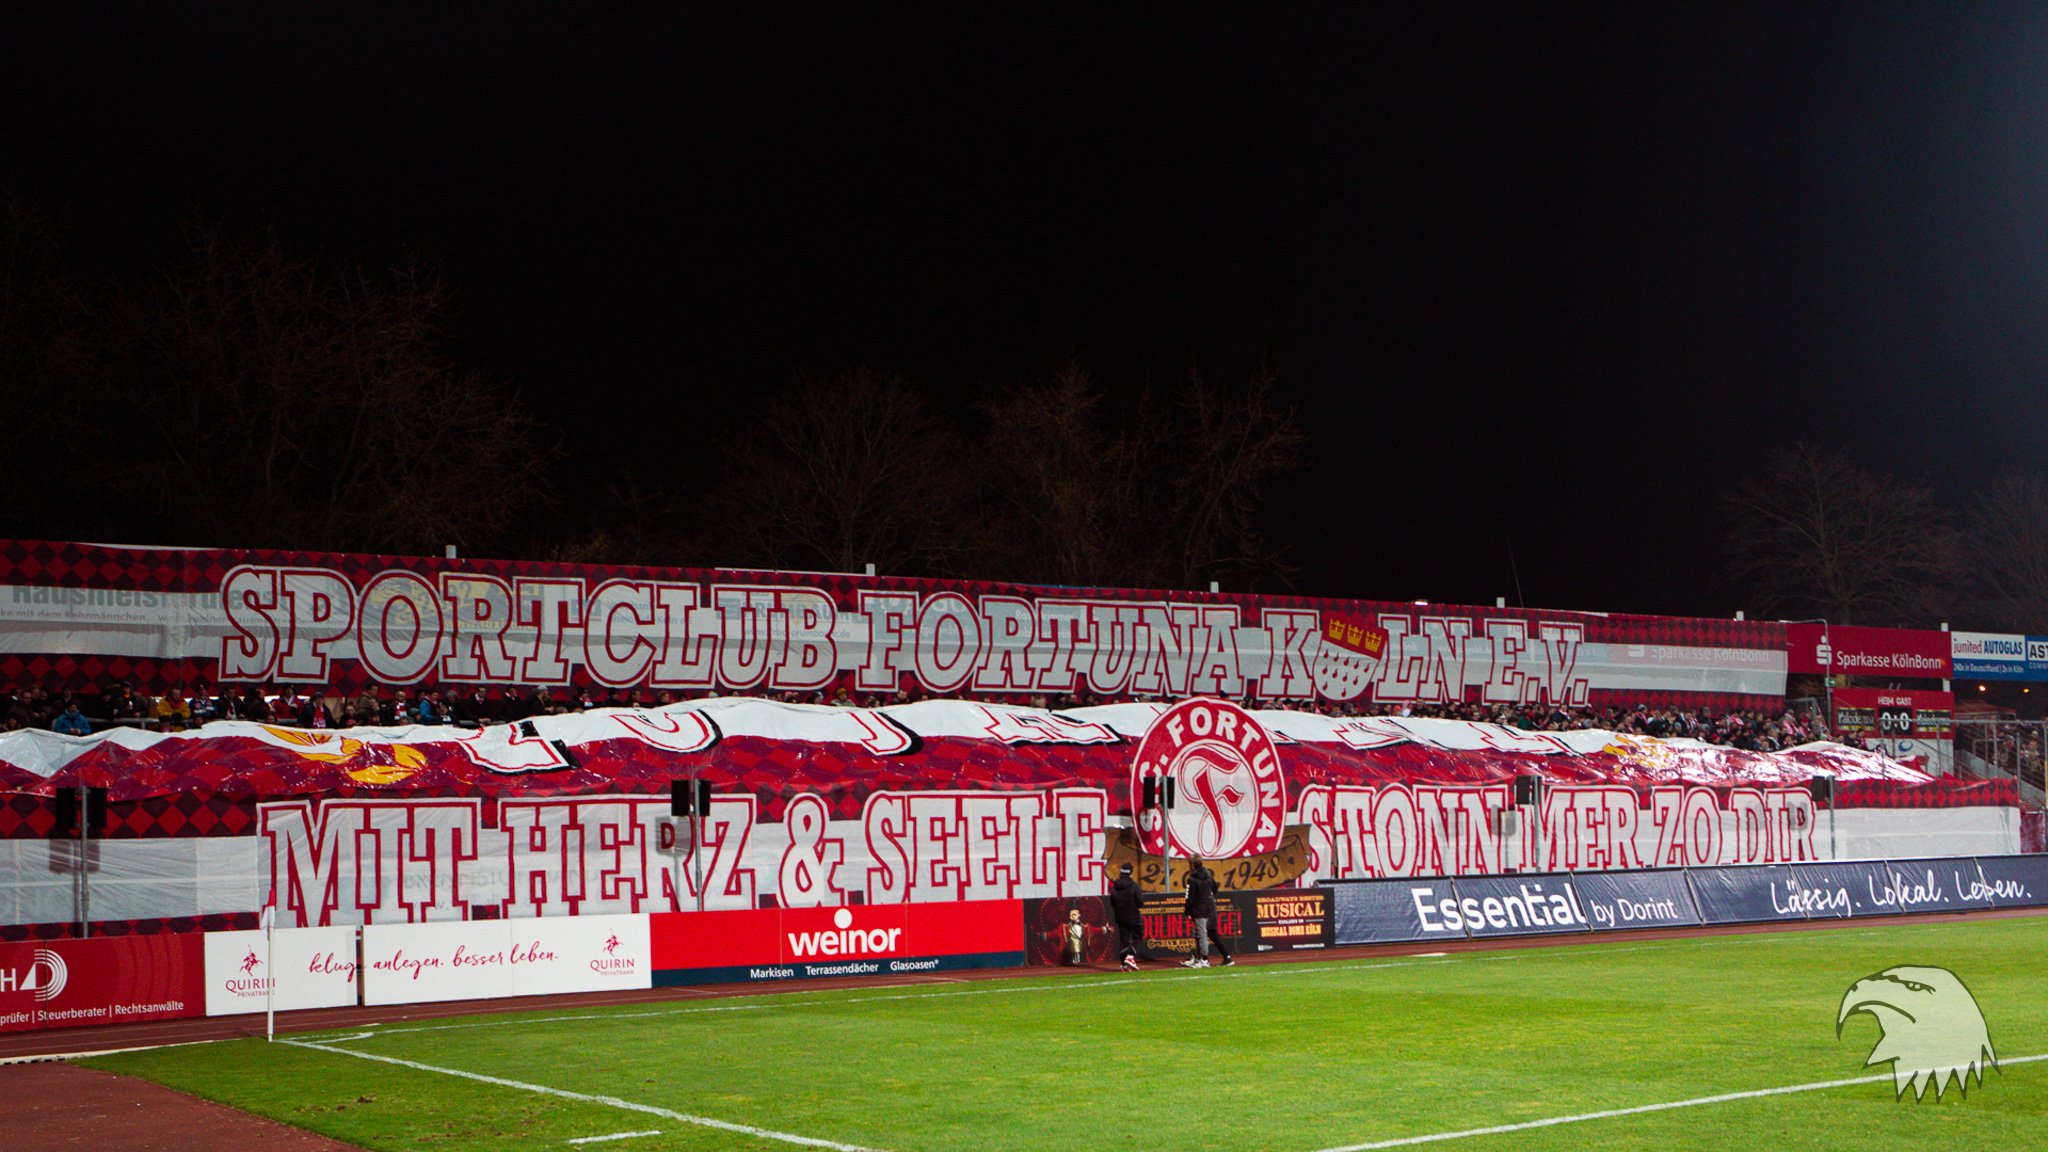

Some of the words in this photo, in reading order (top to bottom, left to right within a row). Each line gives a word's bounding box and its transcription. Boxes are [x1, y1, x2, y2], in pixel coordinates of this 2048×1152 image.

[217, 562, 840, 691] SPORTCLUB
[857, 588, 1244, 700] FORTUNA
[1478, 617, 1590, 709] E.V.
[1953, 637, 1983, 654] junited
[1983, 640, 2023, 655] AUTOGLAS
[1836, 650, 1890, 669] Sparkasse
[1892, 653, 1942, 669] KölnBonn
[2029, 643, 2048, 659] AS
[1878, 696, 1894, 705] HEIM
[1895, 697, 1912, 706] GAST
[1881, 711, 1910, 731] 0:0
[1165, 706, 1280, 839] FORTUNA
[1296, 783, 1509, 888] STONN
[1650, 785, 1723, 868] ZO
[1729, 788, 1821, 864] DIR
[256, 797, 481, 925] MIT
[497, 792, 758, 919] HERZ
[777, 792, 846, 910] &
[862, 788, 1107, 906] SEELE
[1770, 878, 1861, 917] Lässig.
[1868, 869, 1950, 906] Lokal.
[1954, 863, 2032, 902] Leben.
[1256, 901, 1325, 918] MUSICAL
[1411, 883, 1587, 931] Essential
[1590, 900, 1615, 927] by
[1616, 897, 1679, 921] Dorint
[787, 908, 902, 956] weinor
[1261, 926, 1288, 938] MUSICAL
[1288, 925, 1305, 936] DOME
[1305, 922, 1322, 935] KÖLN
[308, 952, 359, 983] klug
[373, 949, 444, 980] anlegen.
[453, 944, 504, 968] besser
[510, 940, 558, 964] leben.
[590, 958, 635, 973] QUIRIN
[750, 967, 795, 979] Markisen
[805, 962, 879, 976] Terrassendächer
[37, 1007, 107, 1021] Steuerberater
[115, 1000, 184, 1015] Rechtsanwälte
